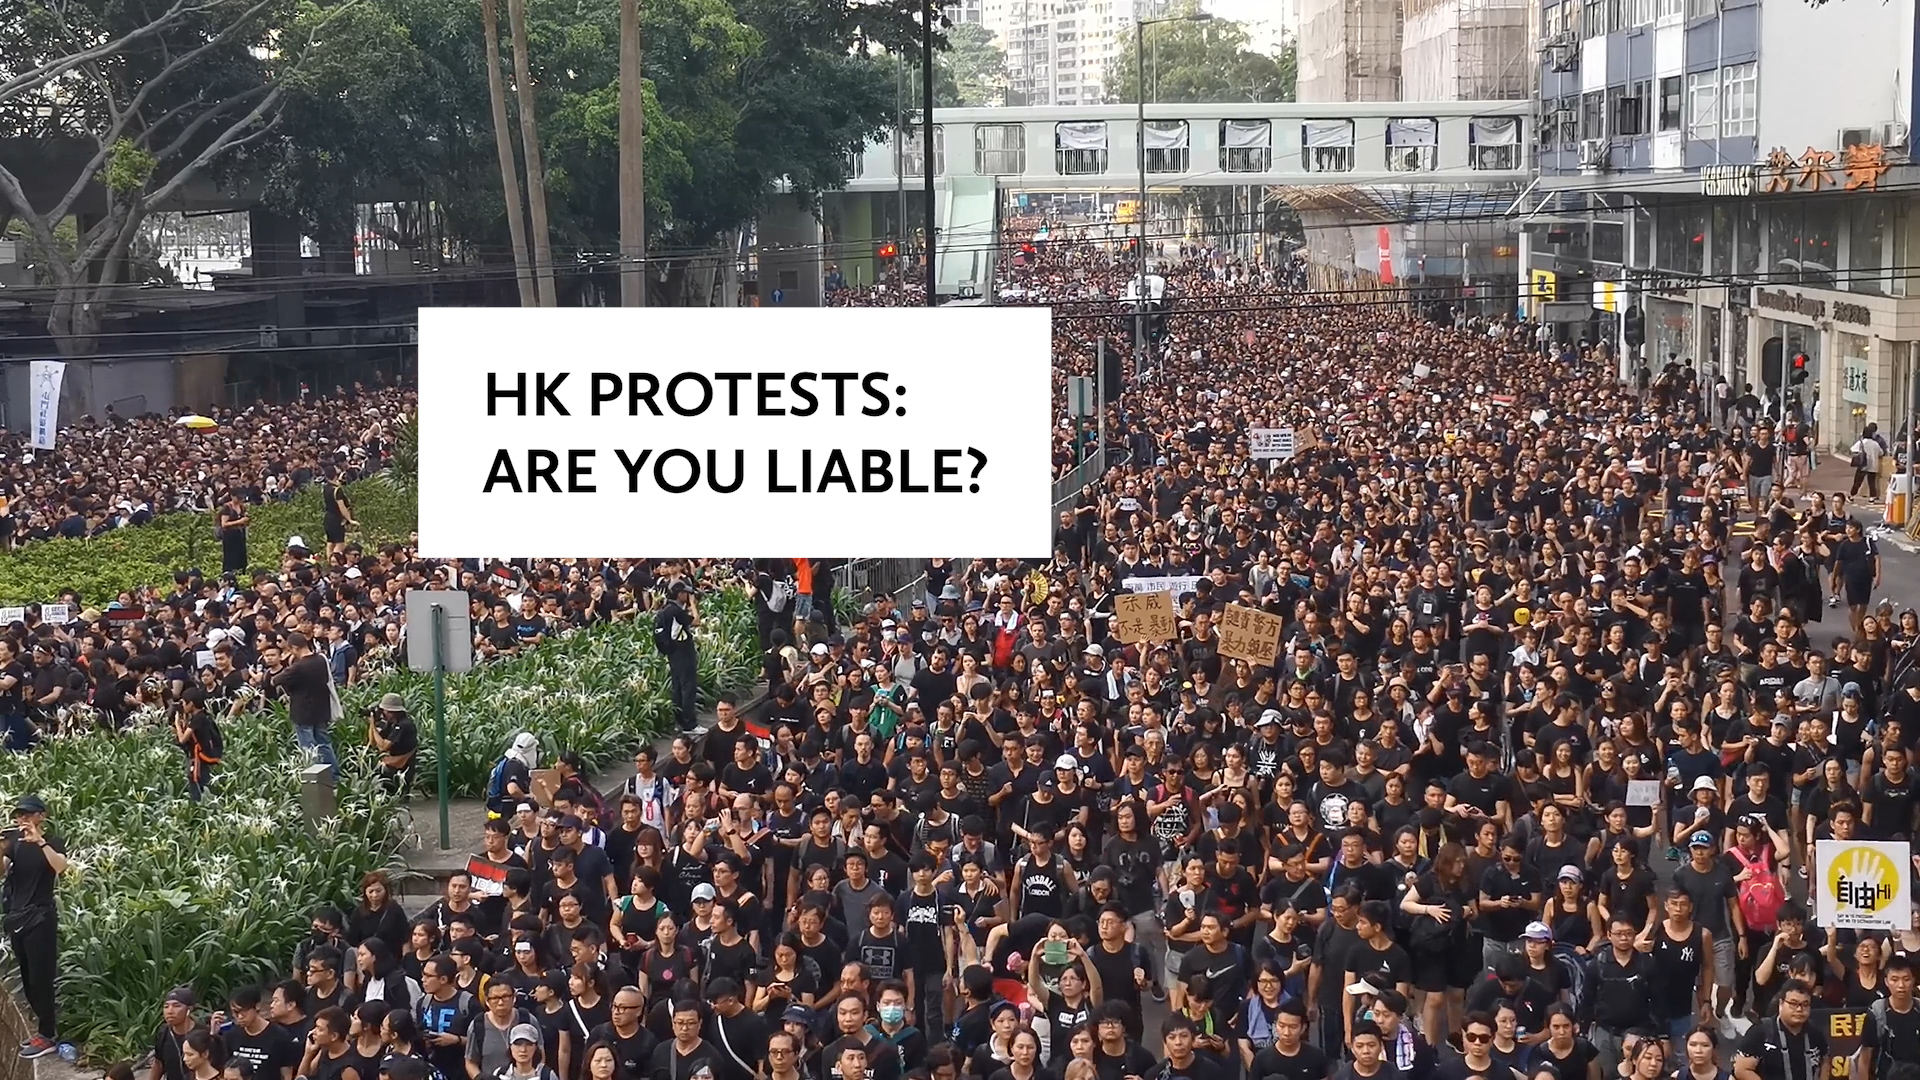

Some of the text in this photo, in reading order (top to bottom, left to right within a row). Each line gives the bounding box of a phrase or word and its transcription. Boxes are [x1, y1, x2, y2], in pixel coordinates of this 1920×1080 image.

[1122, 593, 1162, 613] 示威
[1119, 614, 1175, 637] 不是暴動
[1225, 607, 1280, 637] 譴責警方
[1221, 630, 1275, 661] 暴力鎮壓
[1024, 873, 1057, 892] LONSDALE
[1837, 875, 1891, 911] 自由 Hi
